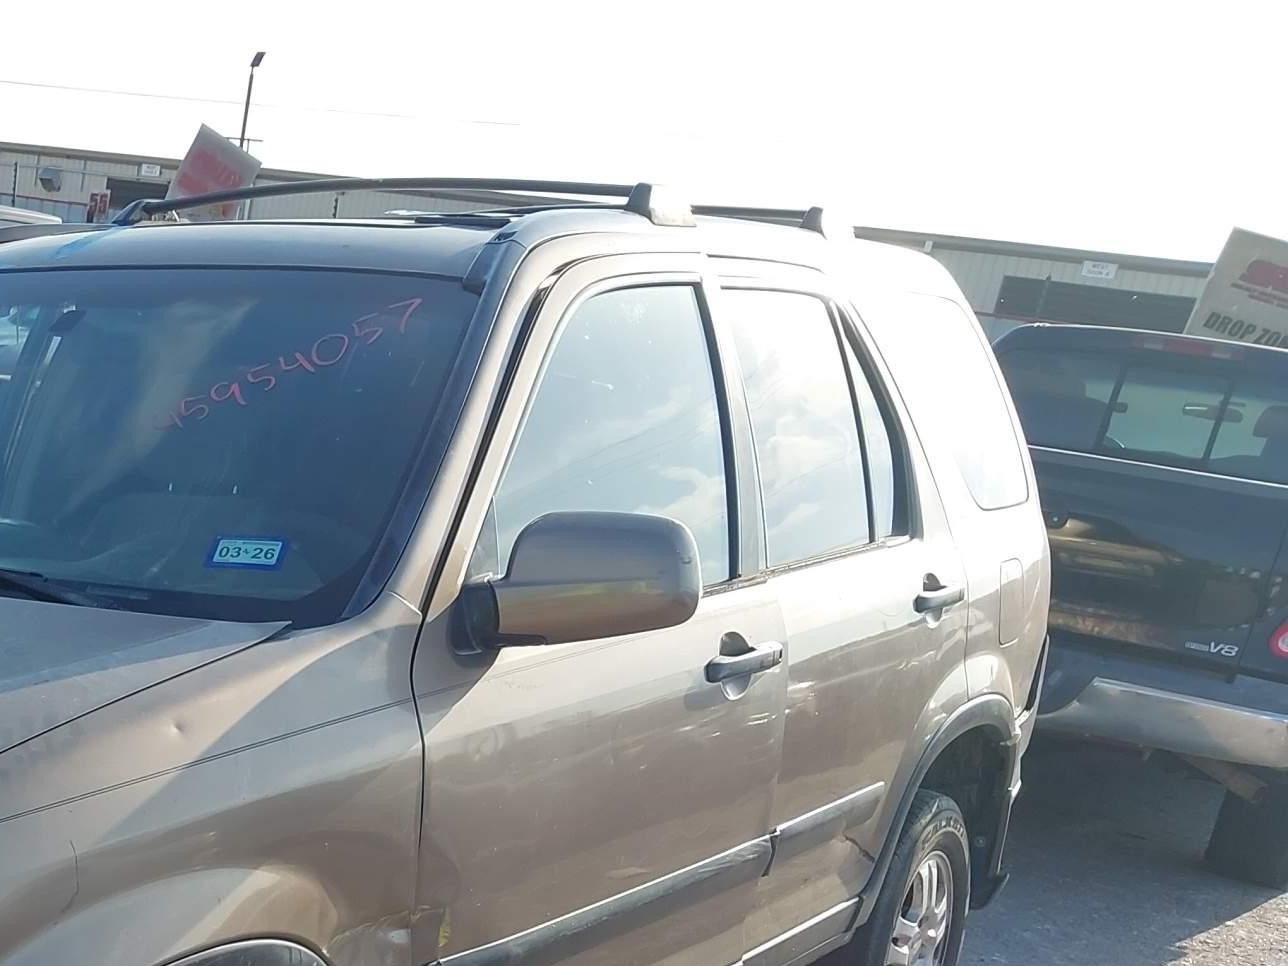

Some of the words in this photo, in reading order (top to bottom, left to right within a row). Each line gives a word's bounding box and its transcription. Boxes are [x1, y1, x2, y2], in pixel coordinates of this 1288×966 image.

[1203, 311, 1257, 339] DROP
[218, 546, 242, 559] 03
[251, 547, 277, 561] 26
[1209, 641, 1240, 657] V8
